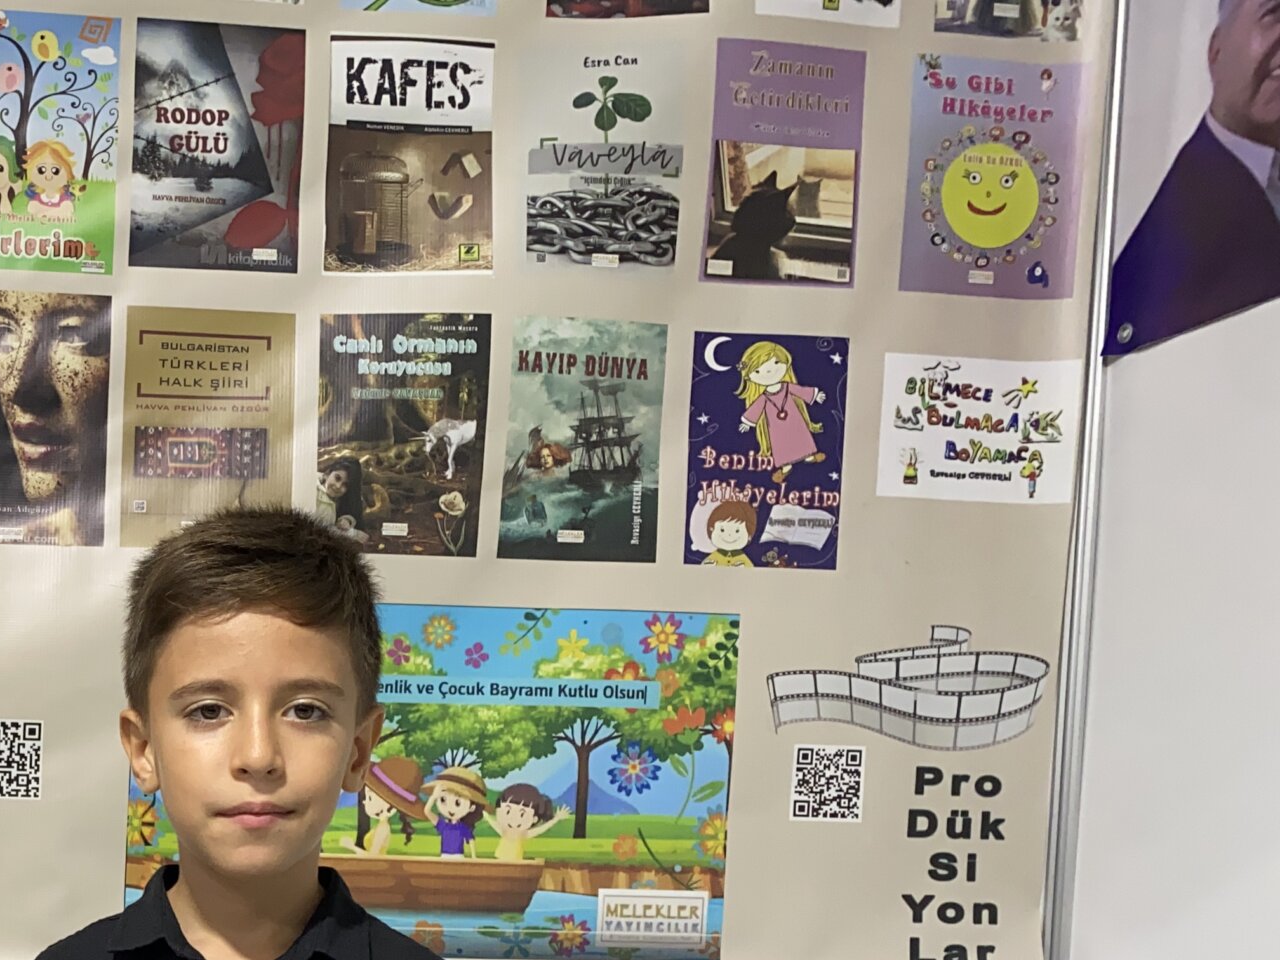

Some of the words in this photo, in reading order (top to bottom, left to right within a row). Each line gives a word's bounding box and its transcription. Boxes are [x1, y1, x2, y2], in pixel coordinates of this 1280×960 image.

[583, 55, 611, 68] Esra
[614, 54, 639, 66] Can
[345, 56, 486, 112] KAFES
[927, 70, 958, 90] Su
[729, 81, 850, 113] Getirdikleri
[154, 105, 230, 127] RODOP
[169, 130, 229, 154] GÜLÜ
[160, 341, 250, 354] BULGARİSTAN
[332, 333, 384, 355] Canlı
[391, 333, 478, 355] Ormanın
[158, 356, 250, 372] TÜRKLERİ
[357, 357, 452, 378] Koruyucusu
[517, 350, 578, 375] KAYIP
[584, 351, 649, 380] DÜNYA
[159, 376, 204, 388] HALK
[210, 376, 249, 392] ŞİİRİ
[135, 403, 170, 412] HAVVA
[173, 404, 227, 413] PEHLİVAN
[926, 405, 1019, 433] BULMACA
[697, 445, 775, 472] Benim
[699, 479, 840, 509] Hikâyelerim
[417, 684, 435, 695] ve
[438, 681, 485, 699] Çocuk
[489, 683, 554, 700] Bayramı
[557, 684, 599, 699] Kutlu
[602, 684, 646, 700] Olsun
[913, 765, 1003, 798] Pro
[906, 808, 1006, 841] Dük
[927, 851, 978, 883] Si
[605, 903, 700, 920] MELEKLER
[901, 893, 999, 925] Yon
[604, 920, 700, 934] YAYINCILIK
